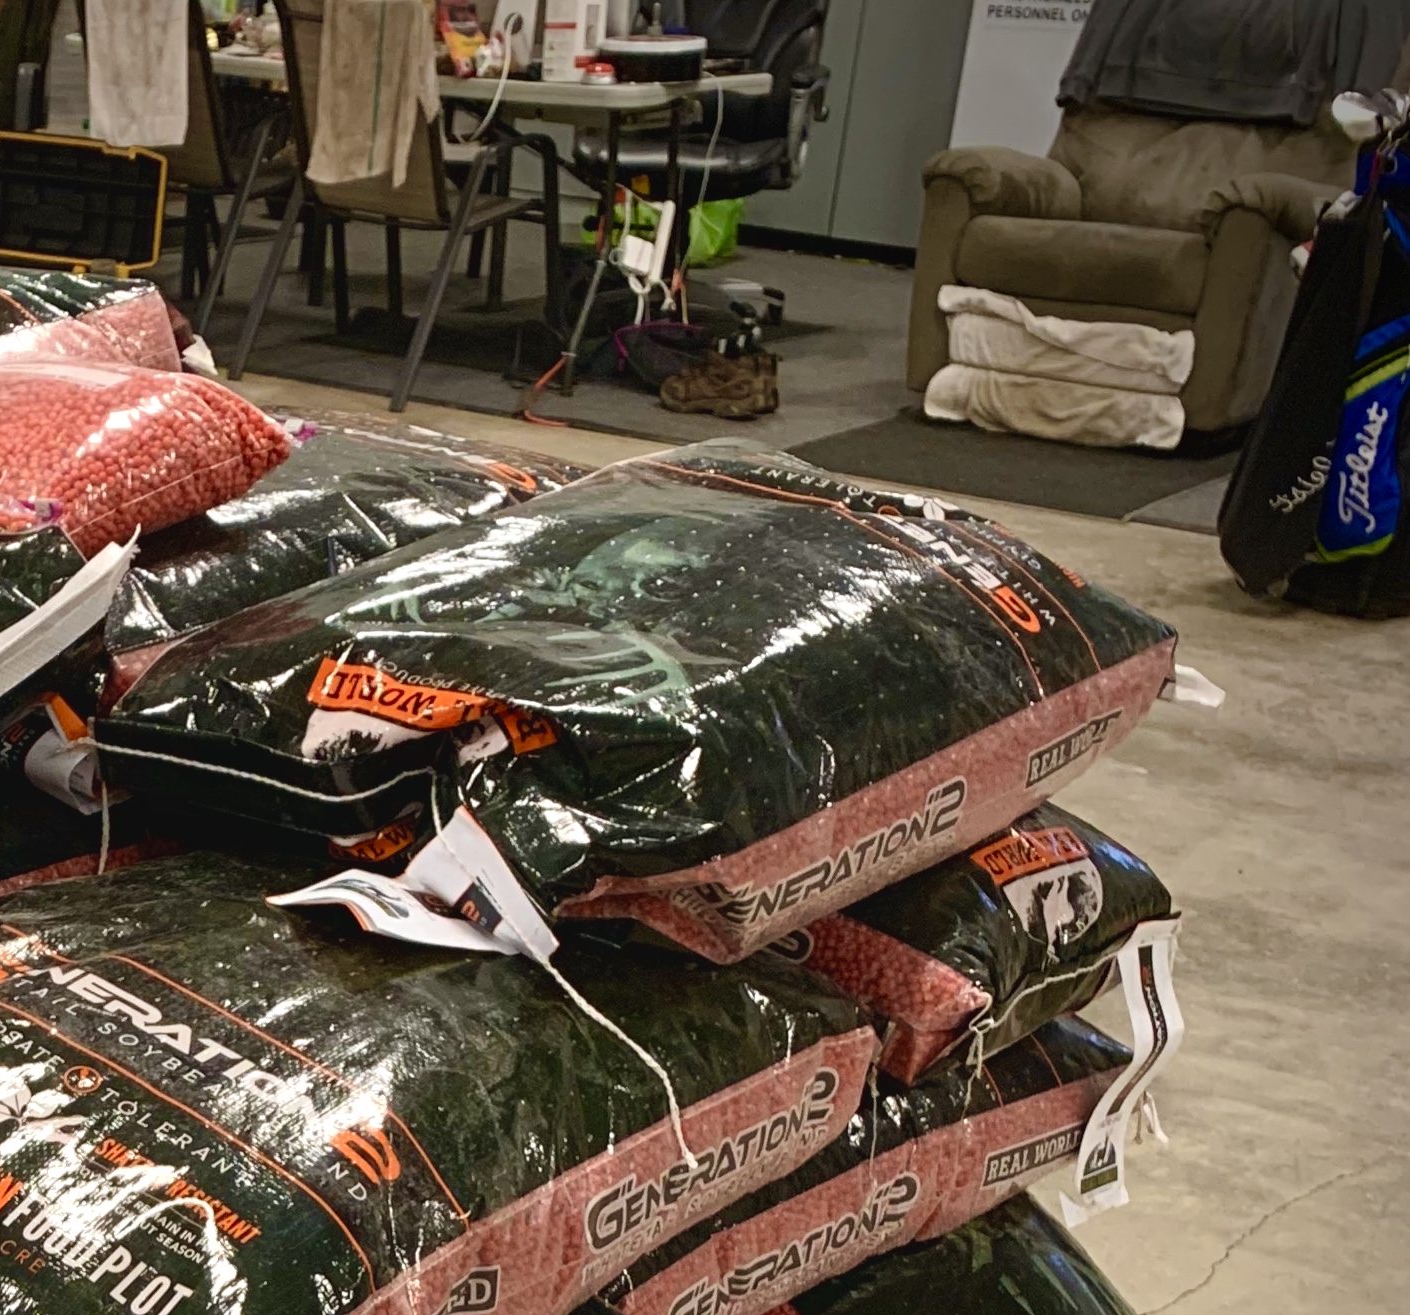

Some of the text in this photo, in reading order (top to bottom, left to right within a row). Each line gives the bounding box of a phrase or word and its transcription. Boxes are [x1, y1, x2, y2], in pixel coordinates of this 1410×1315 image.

[987, 5, 1066, 21] PERSONNEL
[1338, 401, 1388, 533] Titleist
[1029, 744, 1067, 782] REAL
[987, 1128, 1082, 1182] REAL WORL
[156, 1231, 206, 1265] SEASON
